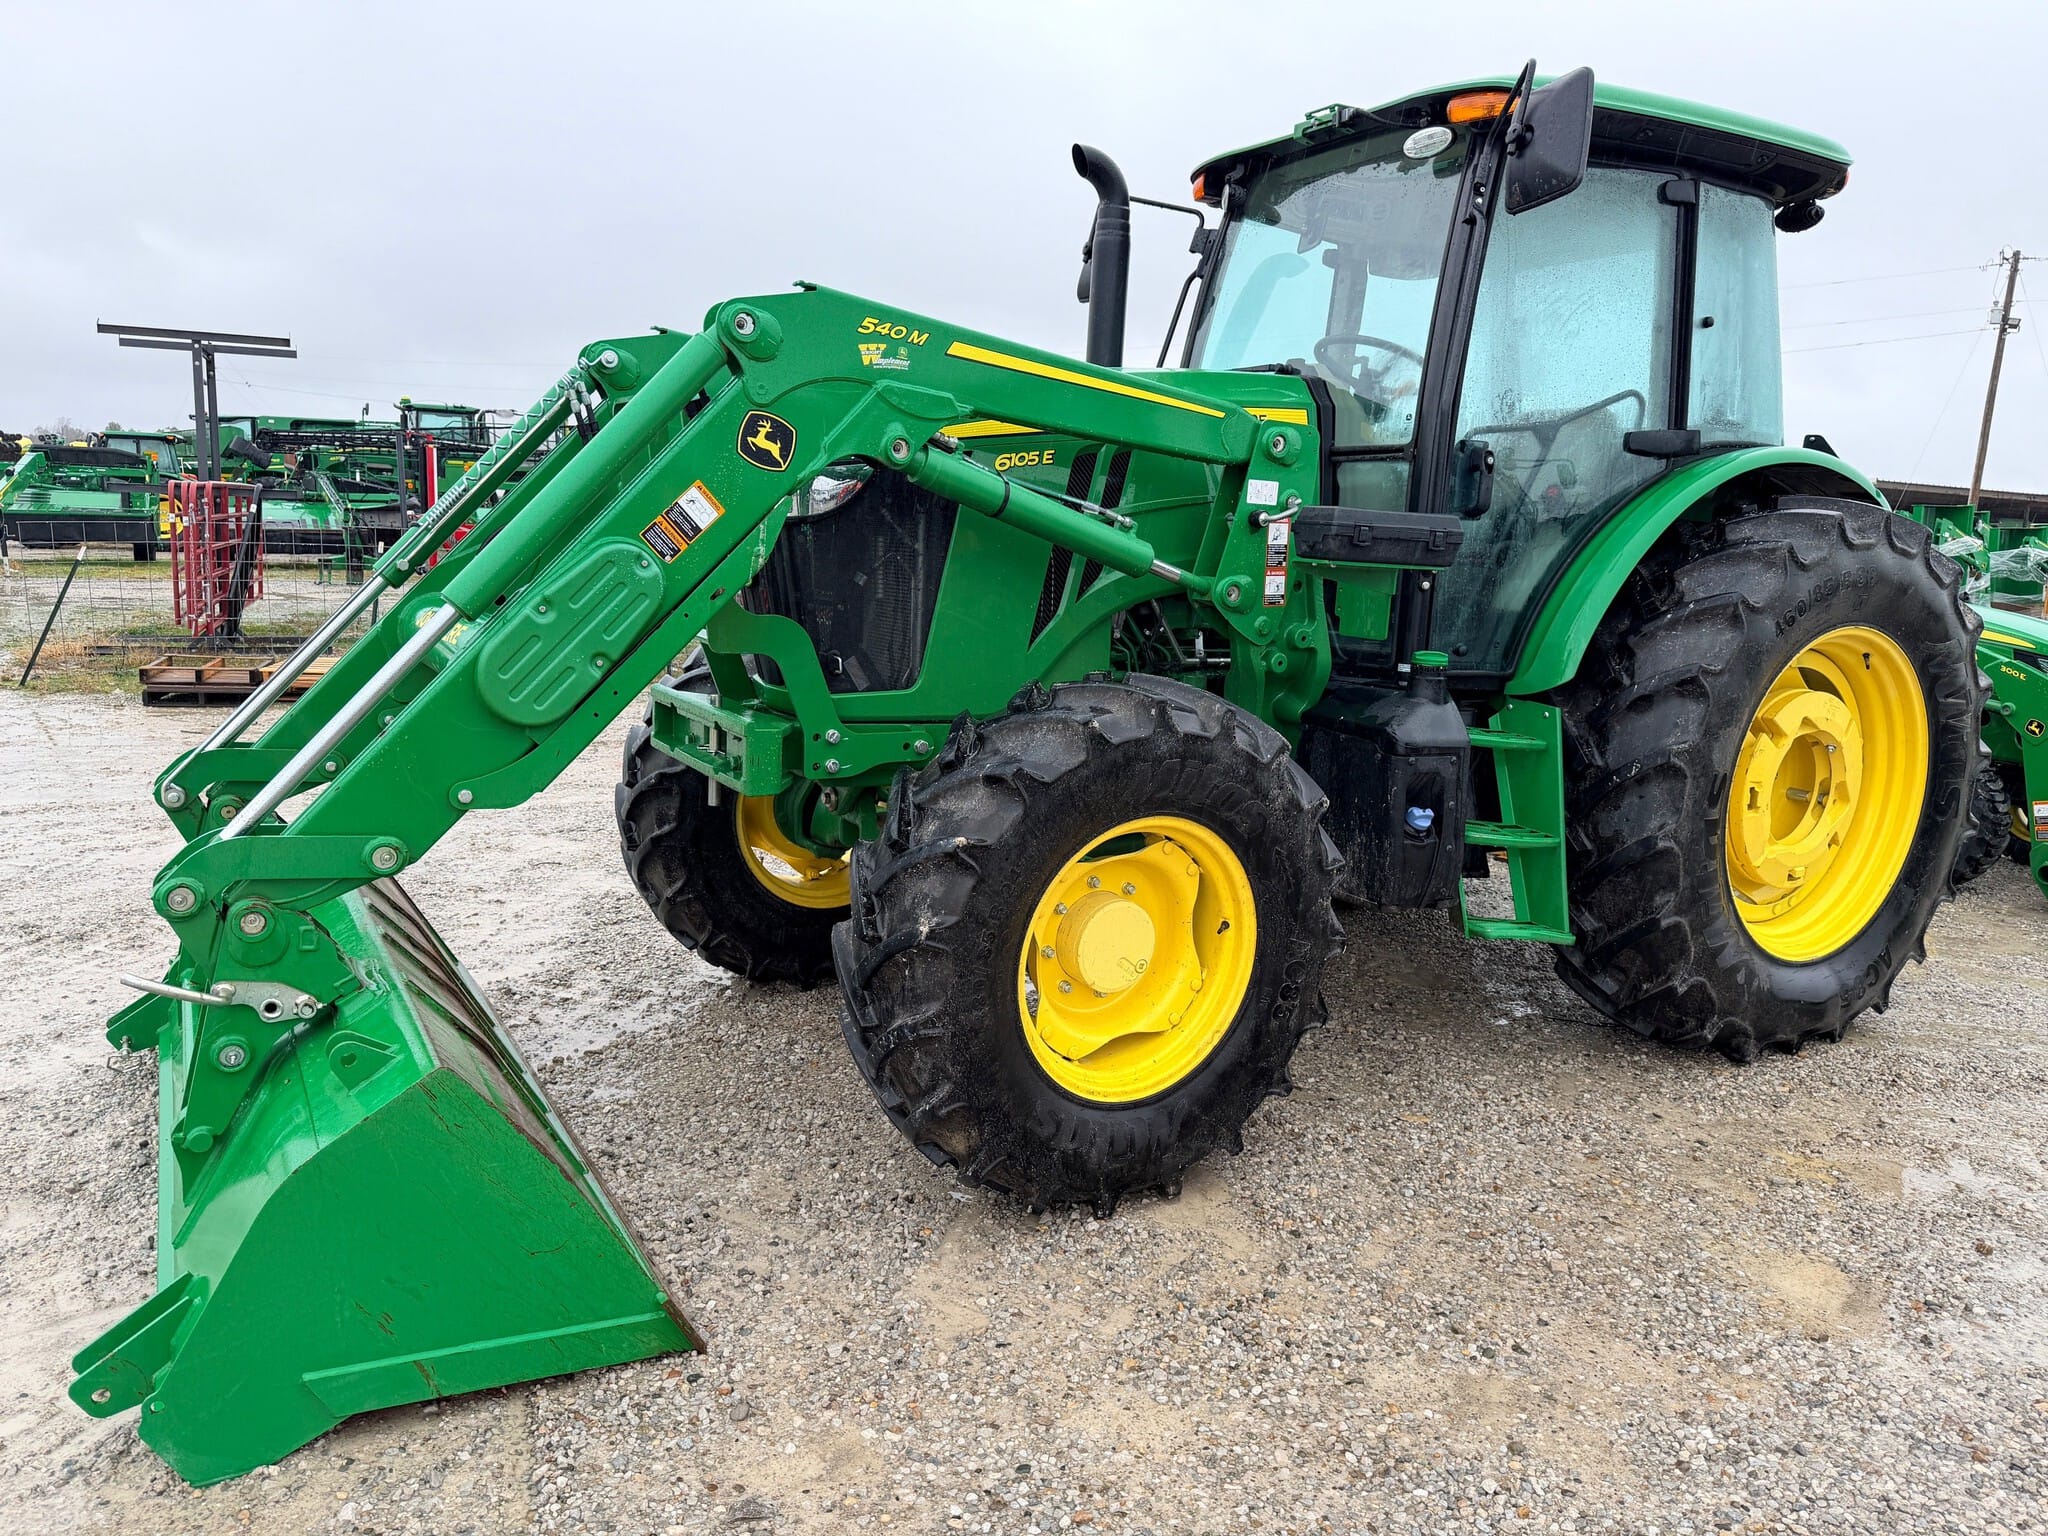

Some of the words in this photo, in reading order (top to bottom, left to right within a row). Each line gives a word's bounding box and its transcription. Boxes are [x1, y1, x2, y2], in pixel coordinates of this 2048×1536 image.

[857, 316, 908, 339] 540
[907, 328, 930, 347] M
[994, 451, 1040, 472] 6105
[1041, 448, 1056, 465] E
[2000, 664, 2020, 678] 300
[2019, 672, 2028, 681] E
